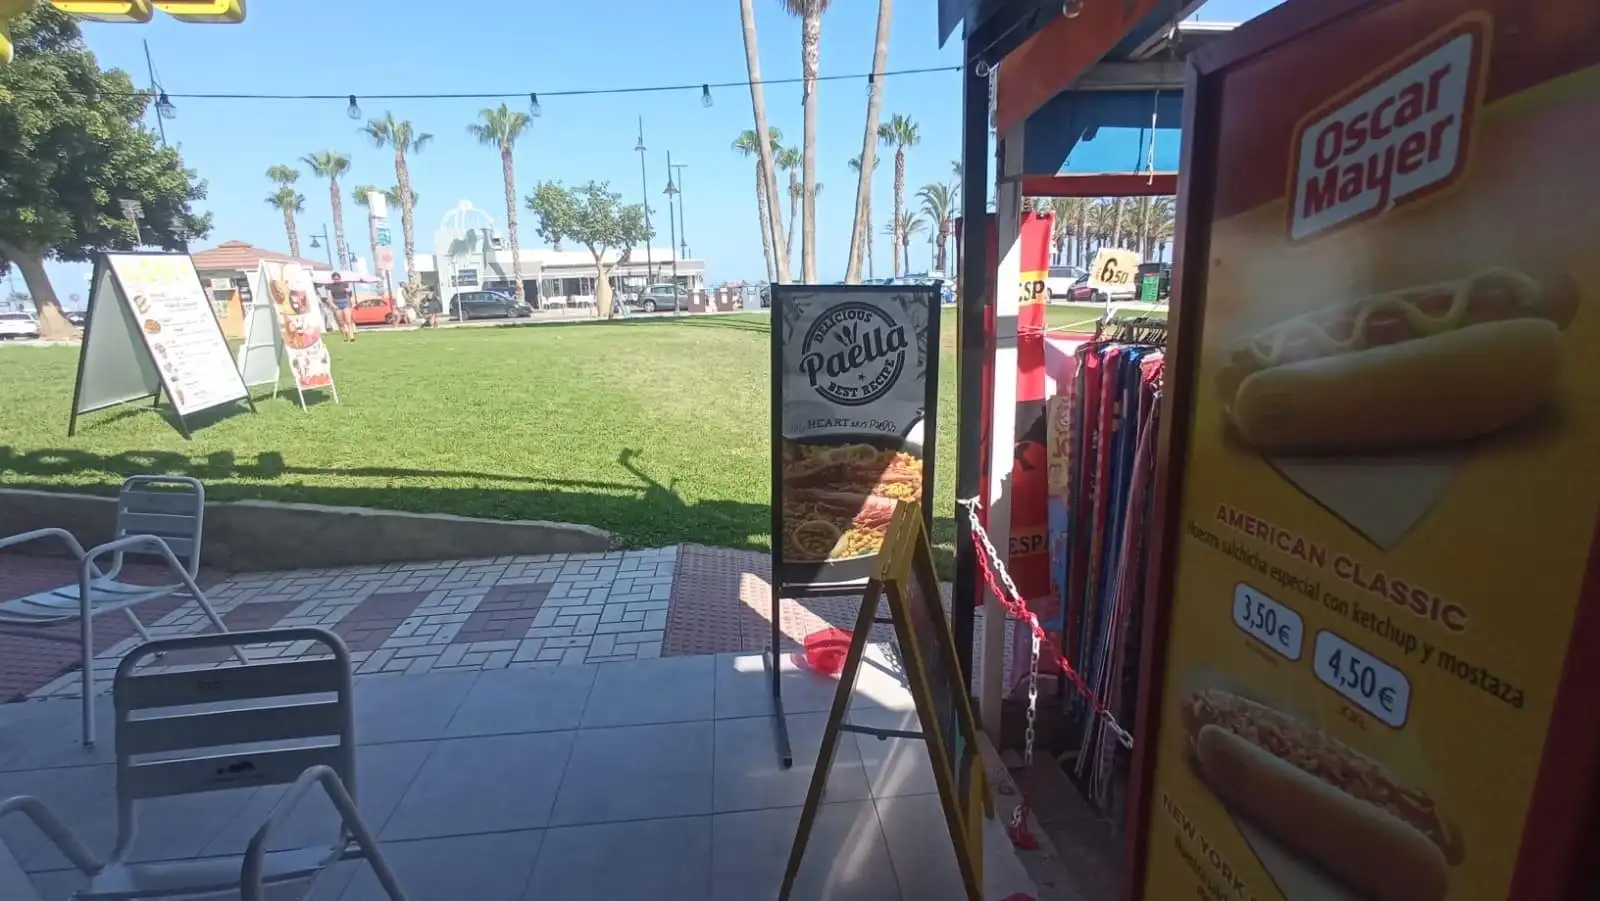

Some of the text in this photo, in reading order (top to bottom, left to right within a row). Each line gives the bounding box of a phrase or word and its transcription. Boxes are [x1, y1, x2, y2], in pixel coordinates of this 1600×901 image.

[1314, 63, 1452, 169] Oscar
[1303, 114, 1455, 218] Mayer
[799, 325, 908, 387] Paella
[813, 310, 873, 344] DELICIOUS
[827, 381, 858, 398] BEST
[861, 358, 895, 396] RECIPE
[807, 418, 850, 429] HEART
[1216, 504, 1468, 632] AMERICAN CLASSIC
[1187, 519, 1525, 709] Nuestra salchicha especial con ketchup y mostaza
[1162, 793, 1196, 840] NEW
[1200, 835, 1246, 900] YORK
